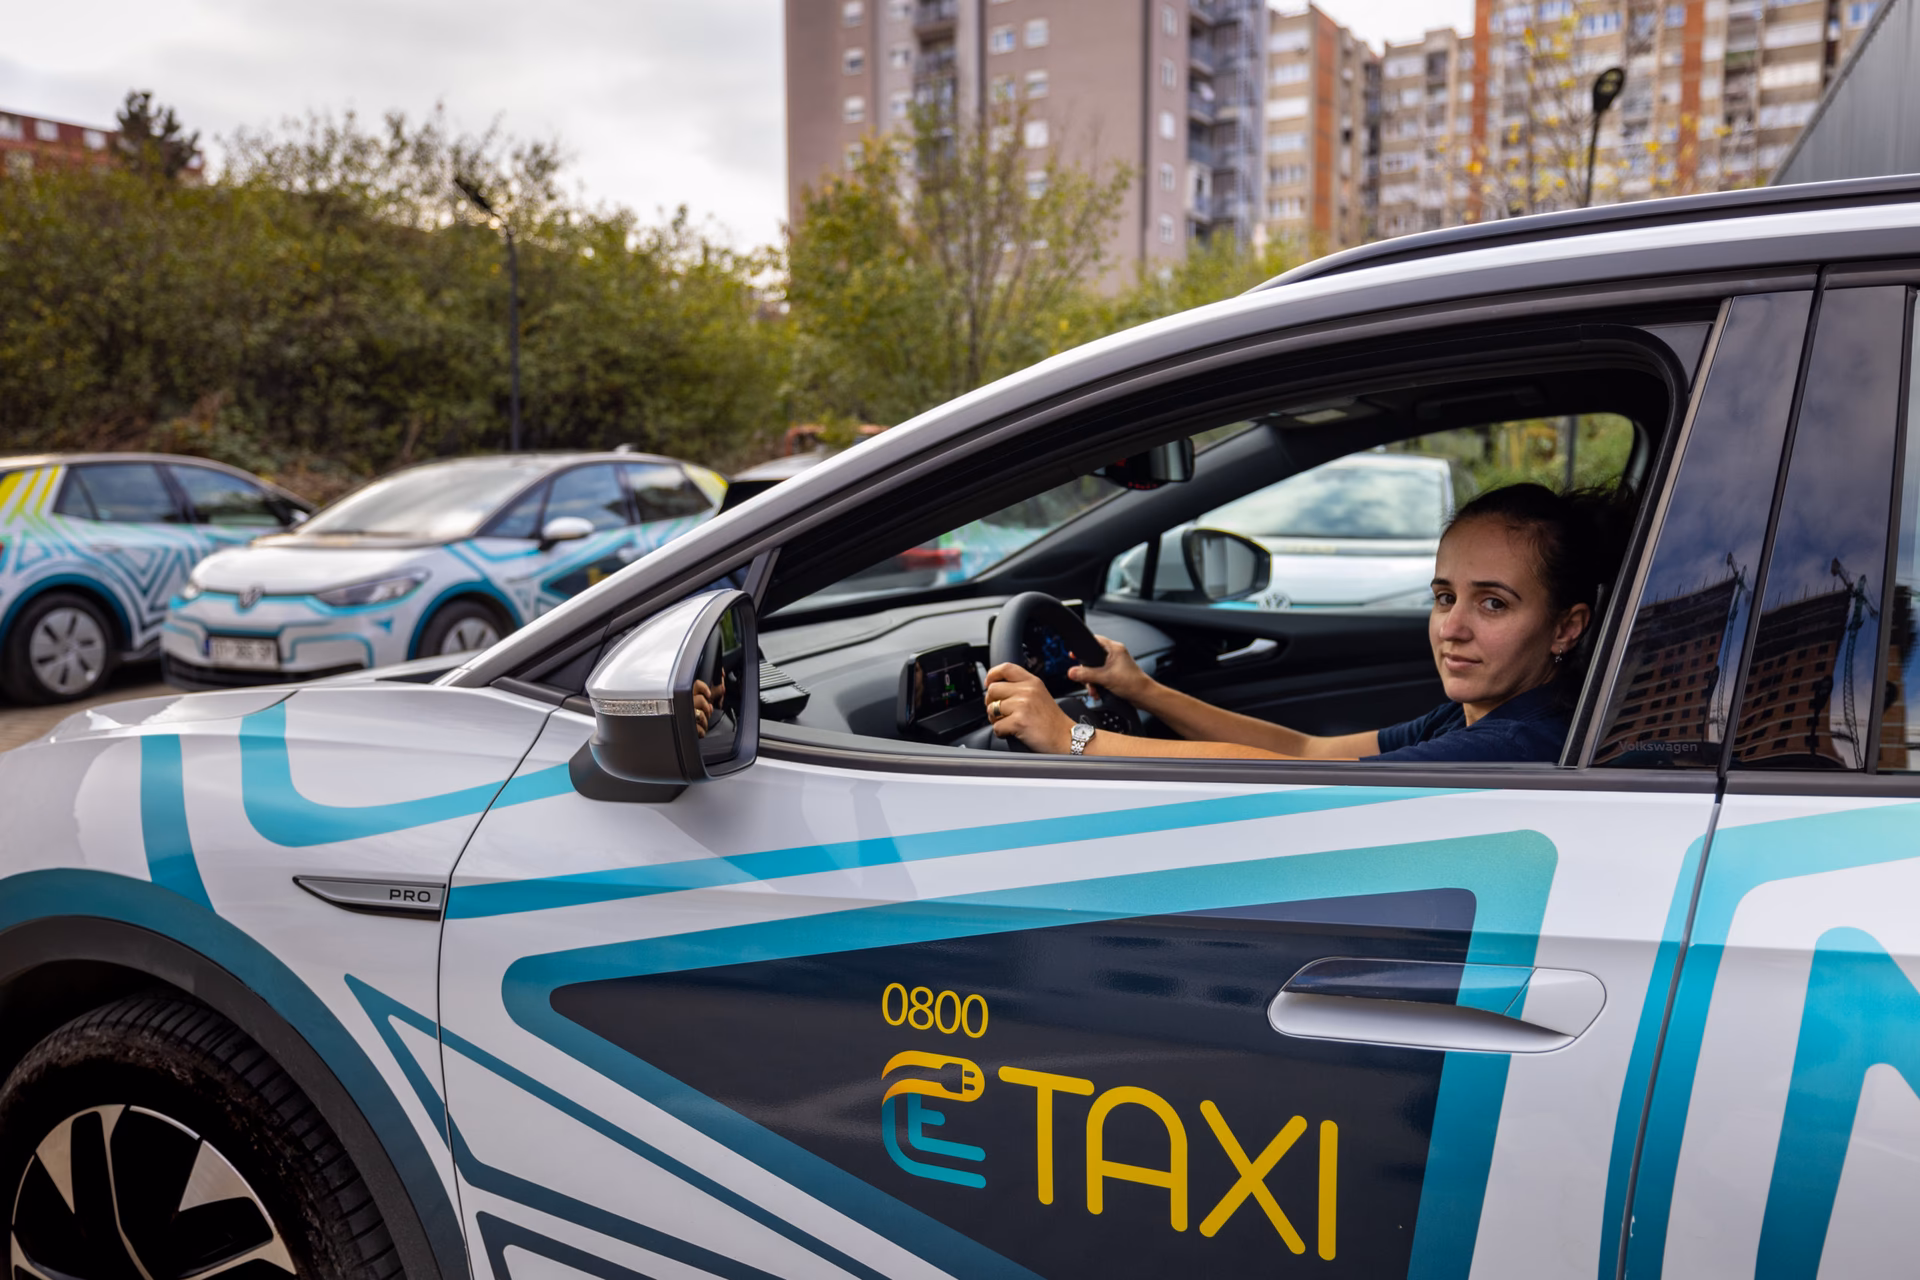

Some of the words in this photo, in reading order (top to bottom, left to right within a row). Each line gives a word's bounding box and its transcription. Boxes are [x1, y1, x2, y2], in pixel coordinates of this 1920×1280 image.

[1619, 741, 1698, 753] Volkswagen
[389, 889, 431, 903] PRO
[882, 982, 989, 1038] 0800
[998, 1065, 1339, 1261] TAXI
